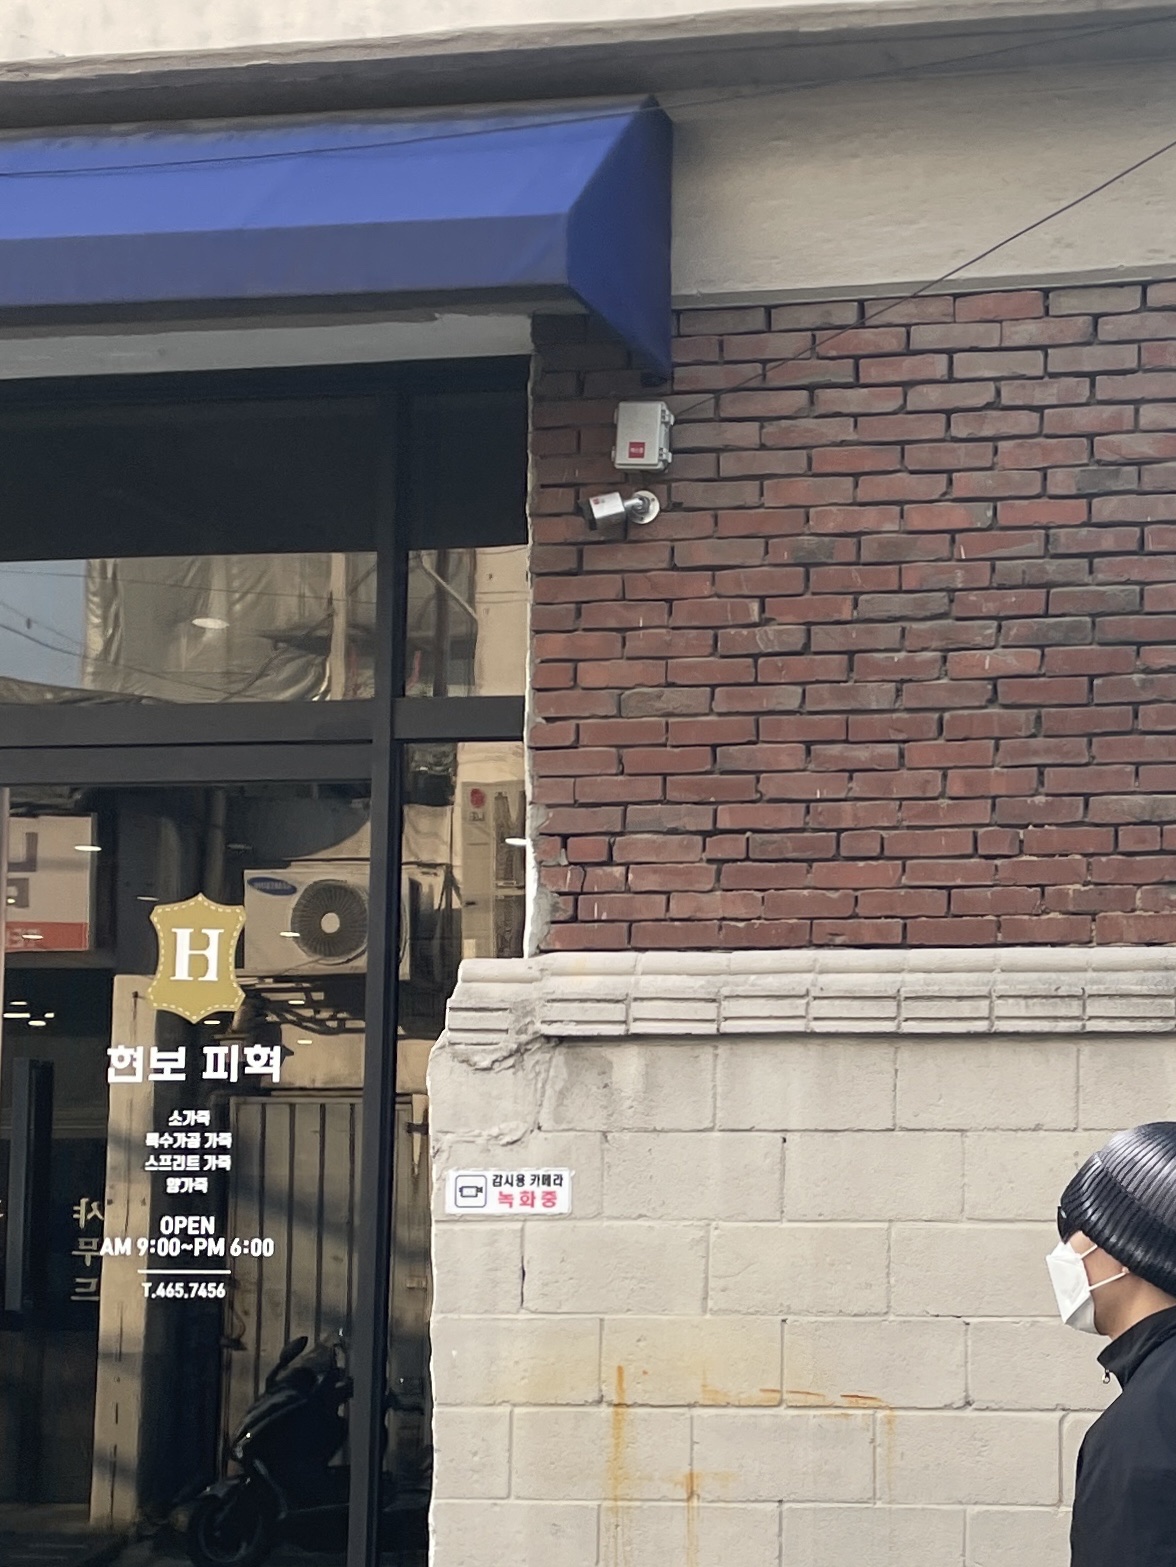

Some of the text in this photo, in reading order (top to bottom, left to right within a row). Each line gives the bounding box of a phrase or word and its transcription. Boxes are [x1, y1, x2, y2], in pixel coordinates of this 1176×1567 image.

[170, 927, 224, 981] H
[107, 1044, 281, 1083] 현보 피혁
[168, 1110, 210, 1126] 소가죽
[145, 1133, 233, 1148] 특수가공 가죽
[144, 1155, 232, 1171] 스프리트 가죽
[492, 1173, 564, 1188] 감시용 카메라
[160, 1215, 215, 1235] OPEN
[100, 1237, 132, 1257] AM
[230, 1237, 275, 1257] 6:00
[141, 1282, 226, 1299] T.465.7456
